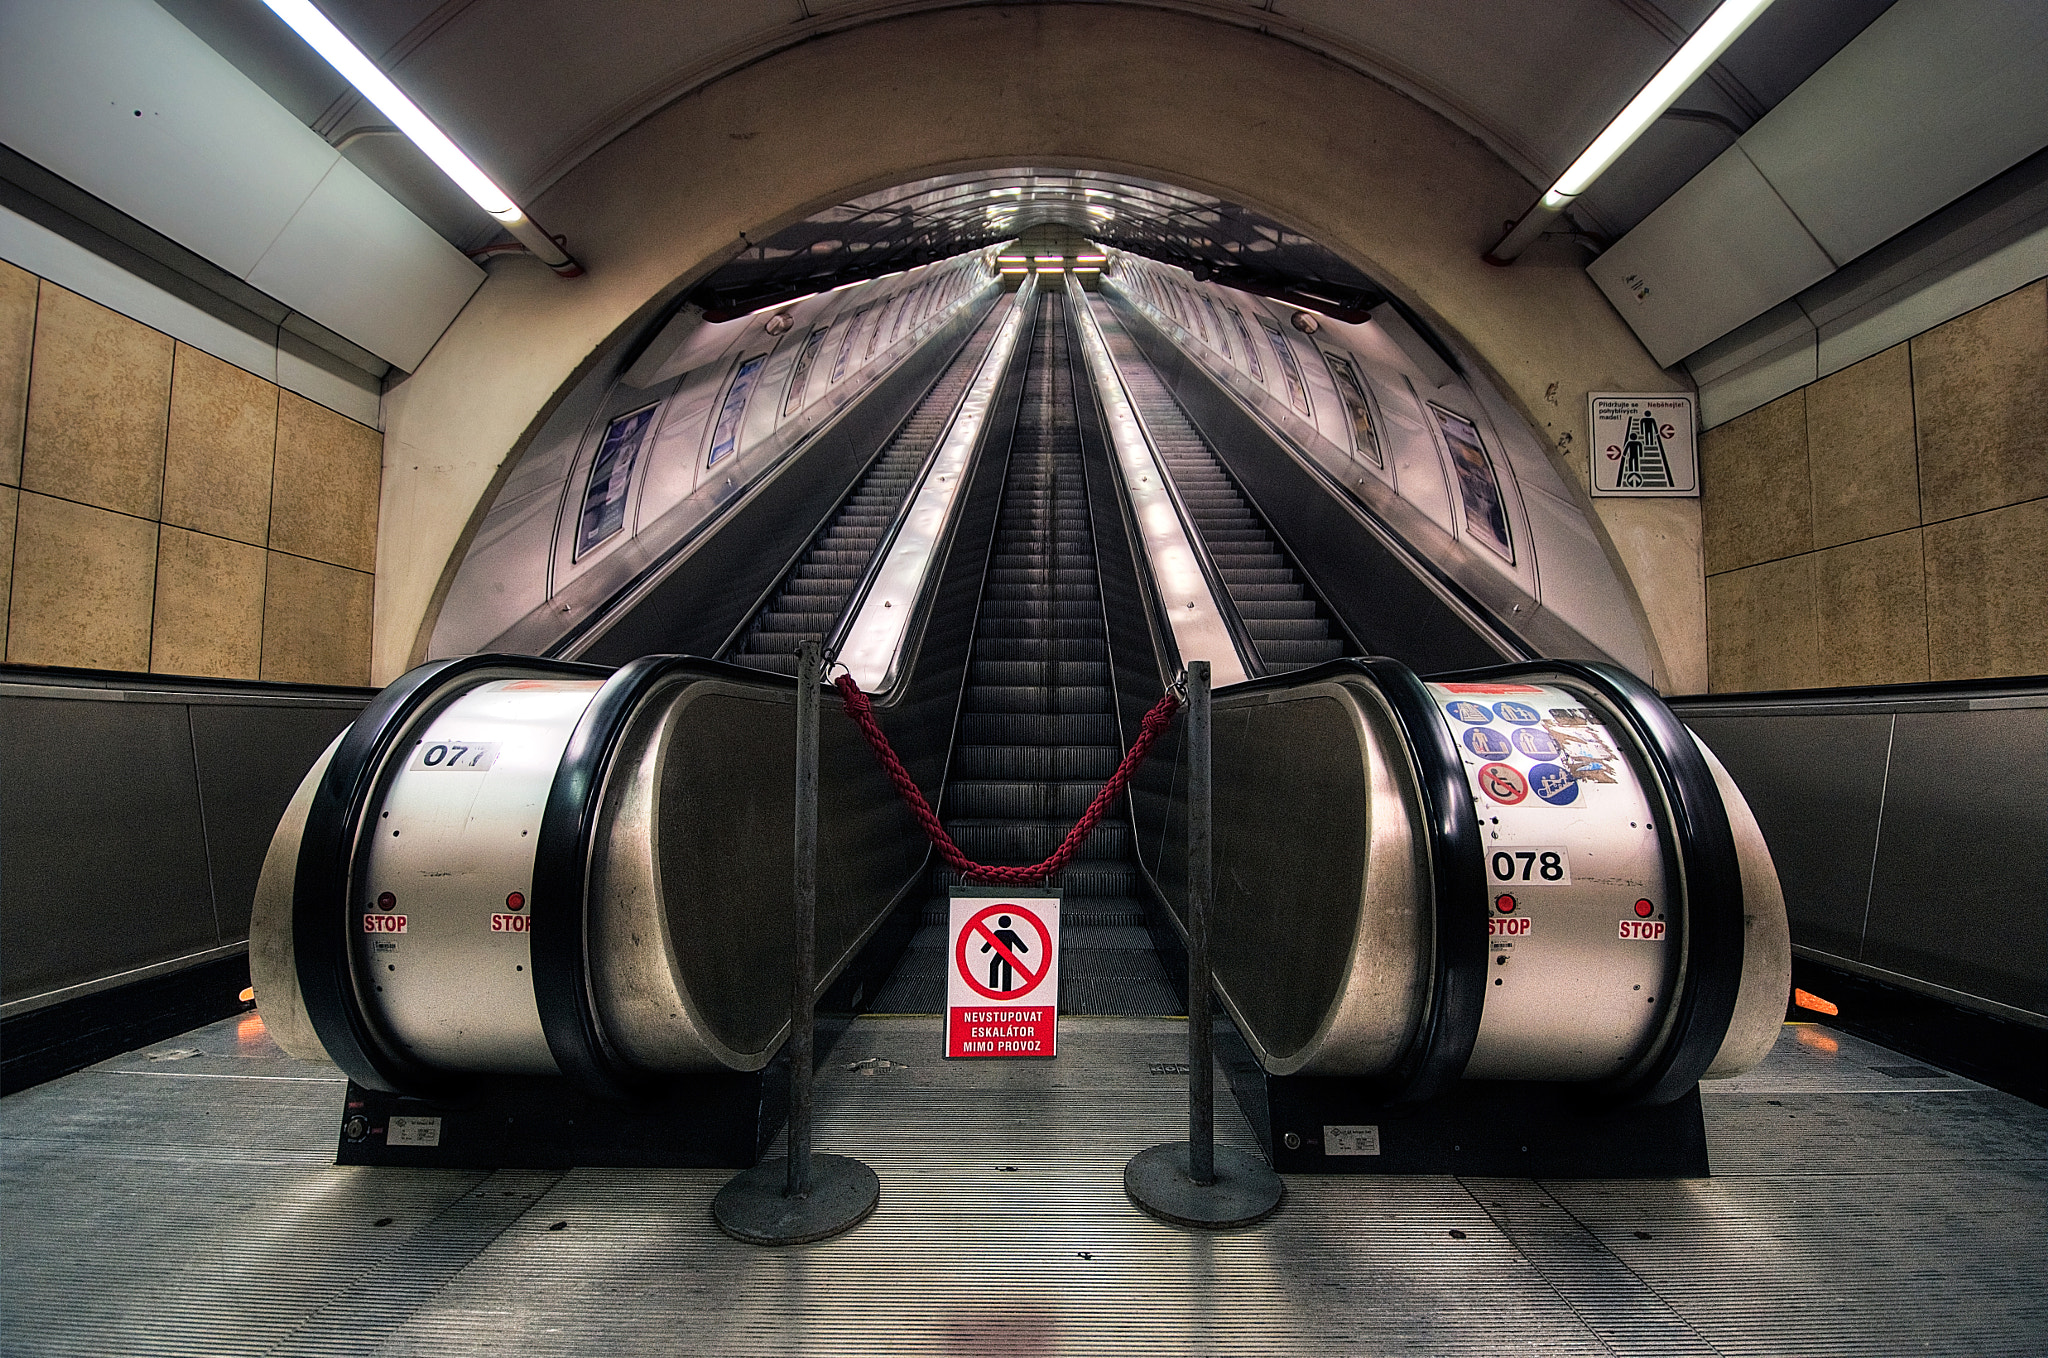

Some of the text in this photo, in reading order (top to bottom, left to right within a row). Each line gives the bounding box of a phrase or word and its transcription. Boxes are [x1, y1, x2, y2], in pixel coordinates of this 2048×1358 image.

[1491, 851, 1564, 881] 078
[365, 915, 407, 932] STOP
[1489, 918, 1530, 935] STOP
[1620, 921, 1665, 939] STOP
[964, 1011, 1043, 1023] NEVSTUPOVAT
[971, 1025, 1035, 1038] ESKALÁTOR
[963, 1040, 1041, 1052] MIMO PROVOZ
